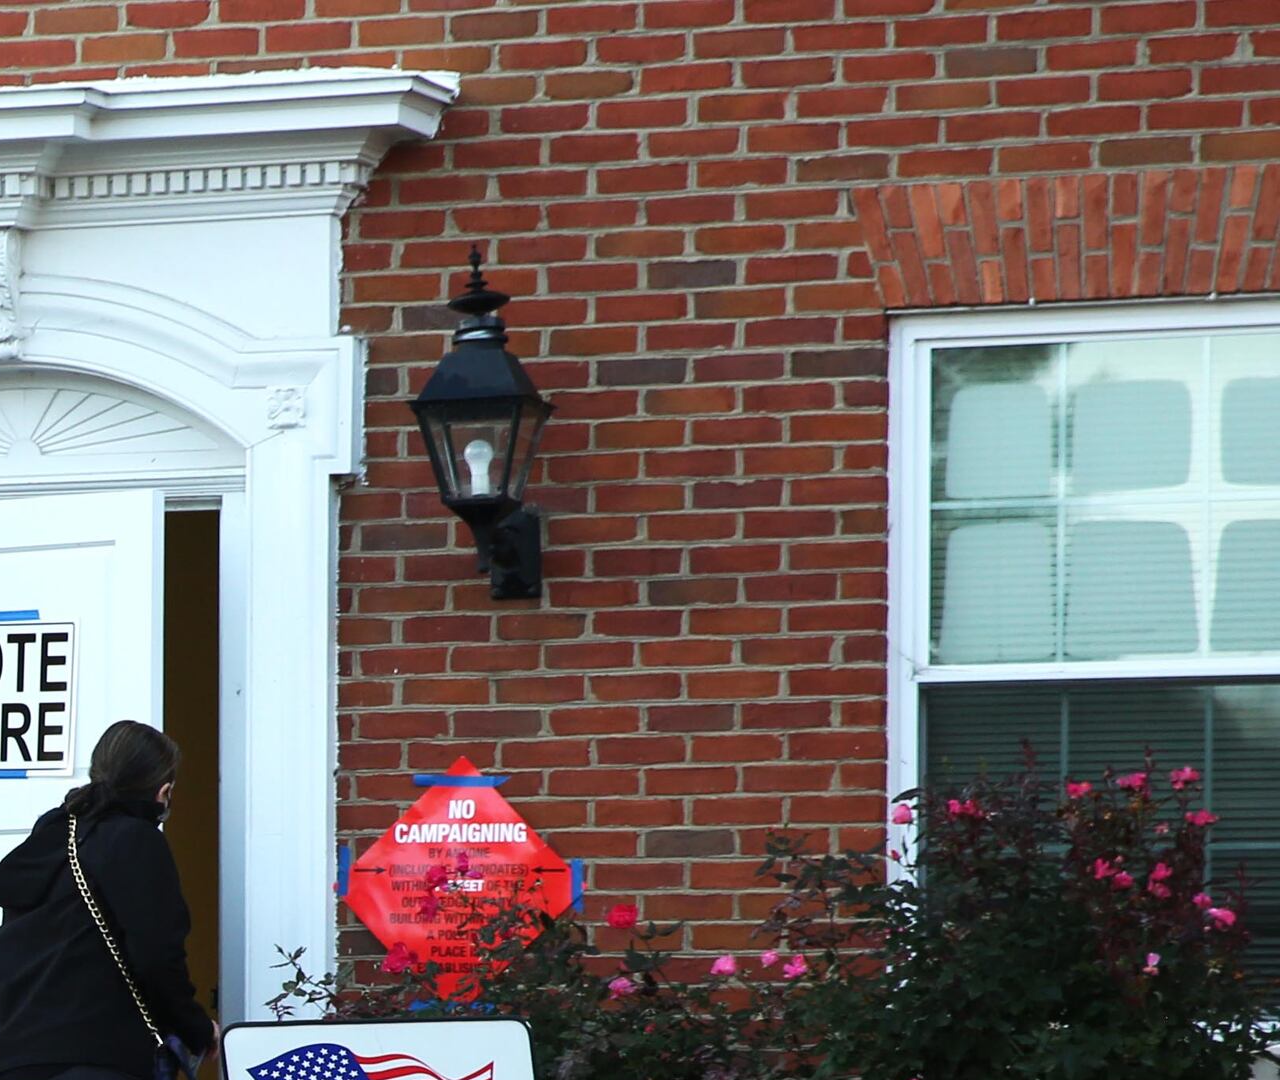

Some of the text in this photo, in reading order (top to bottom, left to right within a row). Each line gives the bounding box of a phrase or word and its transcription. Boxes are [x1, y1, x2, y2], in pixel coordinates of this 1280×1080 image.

[448, 799, 476, 819] NO
[394, 823, 528, 843] CAMPAIGNING
[428, 848, 442, 858] BY
[389, 864, 451, 876] (INCLUG
[431, 946, 466, 957] PLACE
